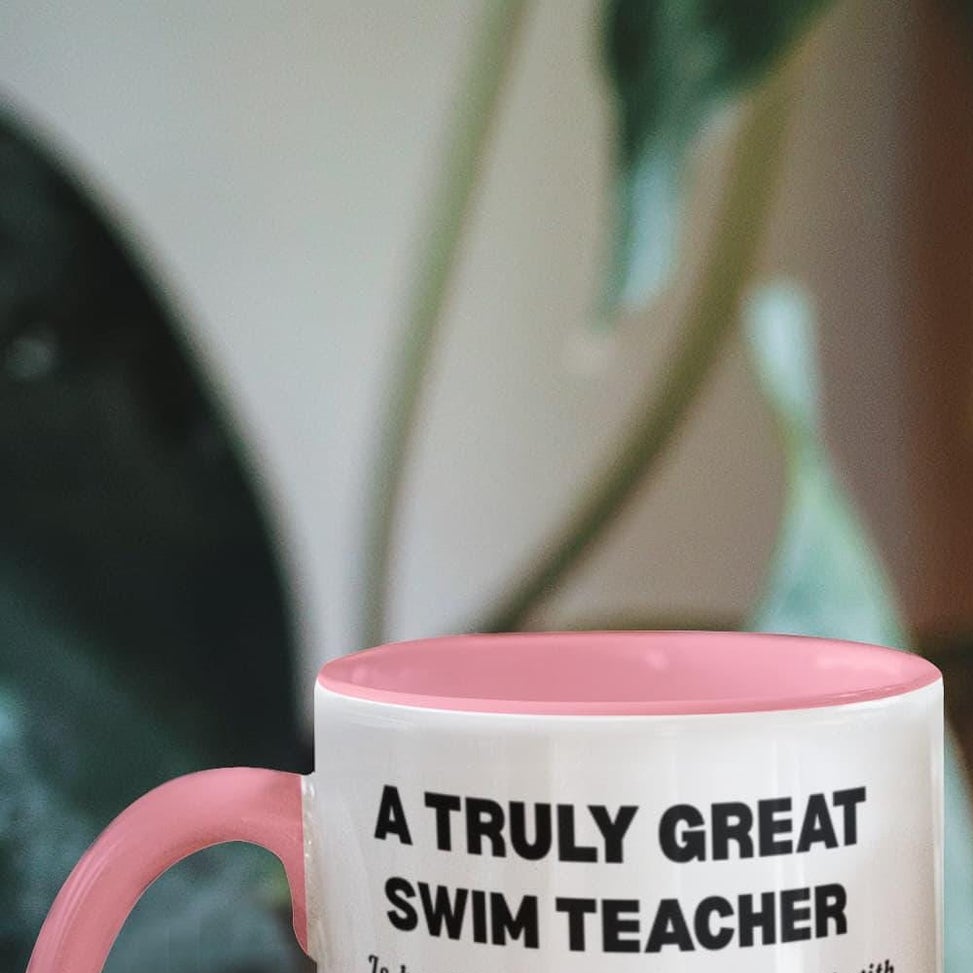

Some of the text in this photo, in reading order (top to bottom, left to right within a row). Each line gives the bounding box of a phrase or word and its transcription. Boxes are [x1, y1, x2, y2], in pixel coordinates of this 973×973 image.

[373, 784, 867, 864] A TRULY GREAT
[384, 876, 848, 954] SWIM TEACHER
